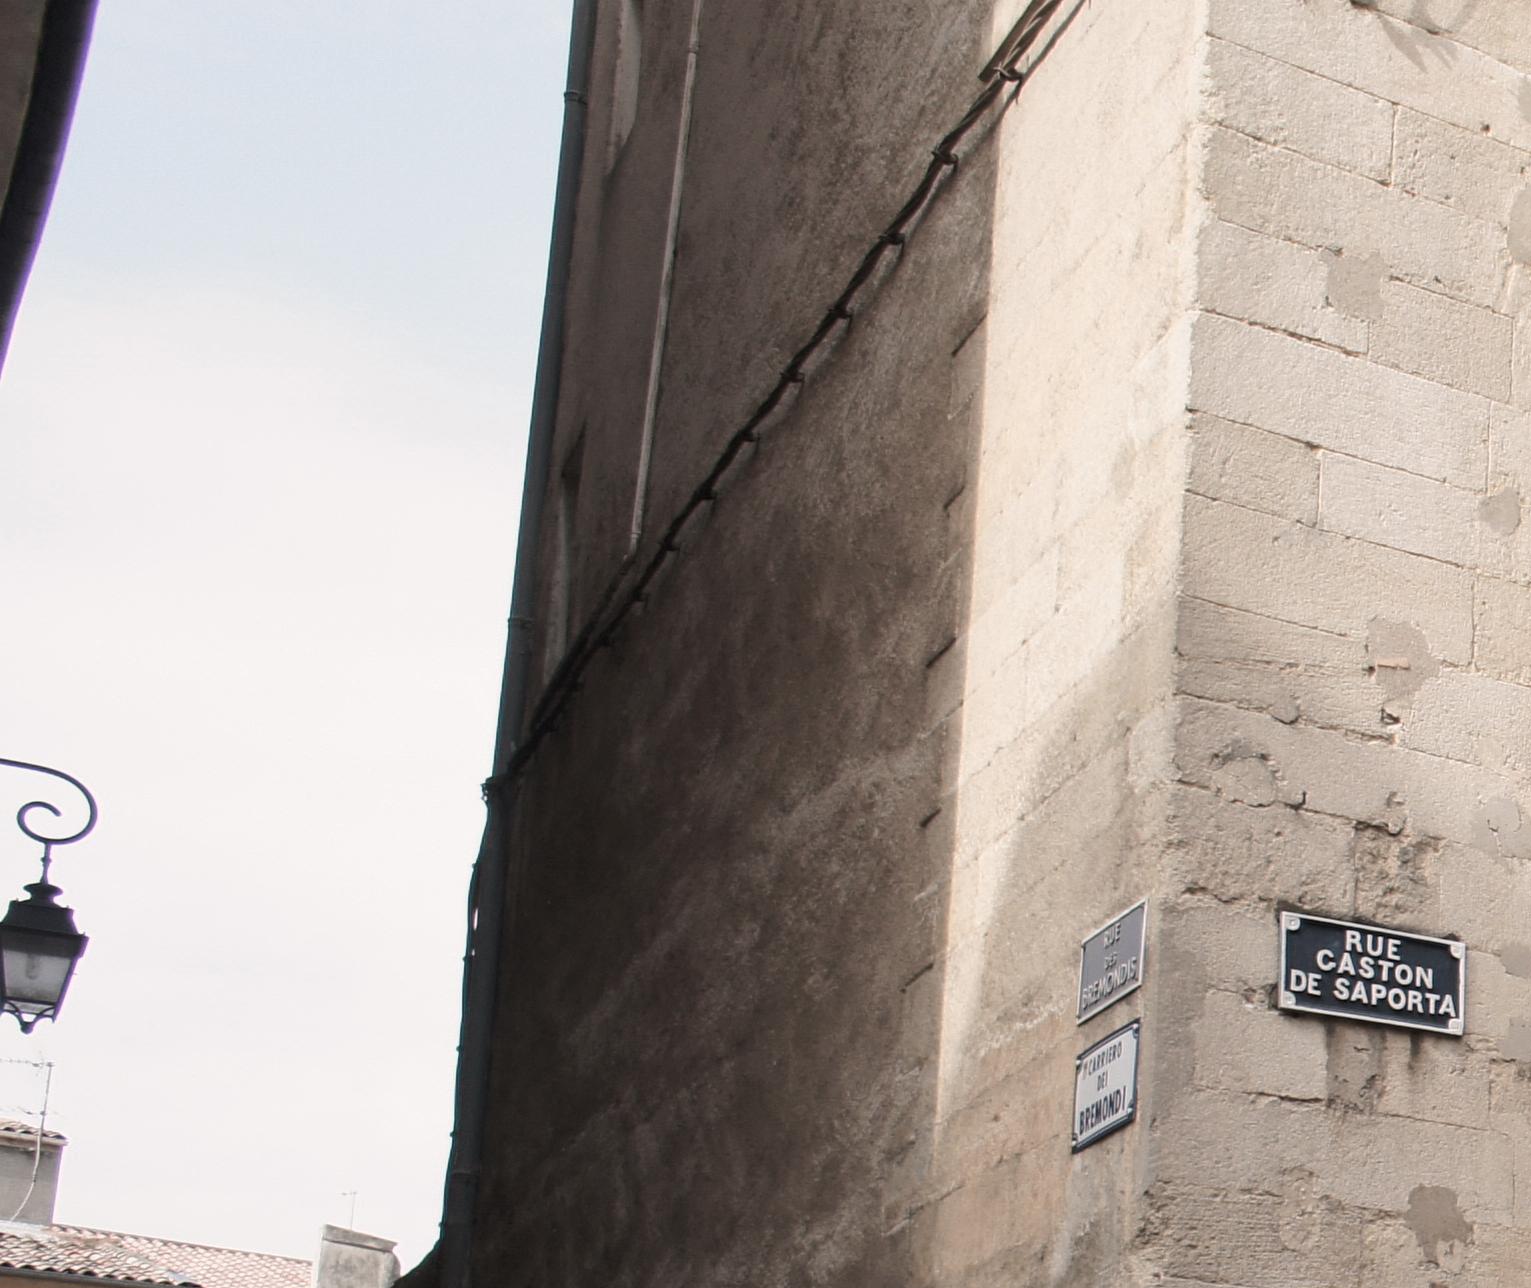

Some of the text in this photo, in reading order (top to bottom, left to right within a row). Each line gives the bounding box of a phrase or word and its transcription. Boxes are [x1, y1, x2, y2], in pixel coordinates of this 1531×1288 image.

[1104, 921, 1121, 949] RUE
[1345, 929, 1402, 961] RUE
[1082, 955, 1138, 1011] BREMONDIS
[1289, 968, 1457, 1018] DE SAPORTA
[1088, 1041, 1123, 1076] CARRIERO
[1097, 1070, 1109, 1092] DEI
[1079, 1085, 1127, 1136] BREMONDI
